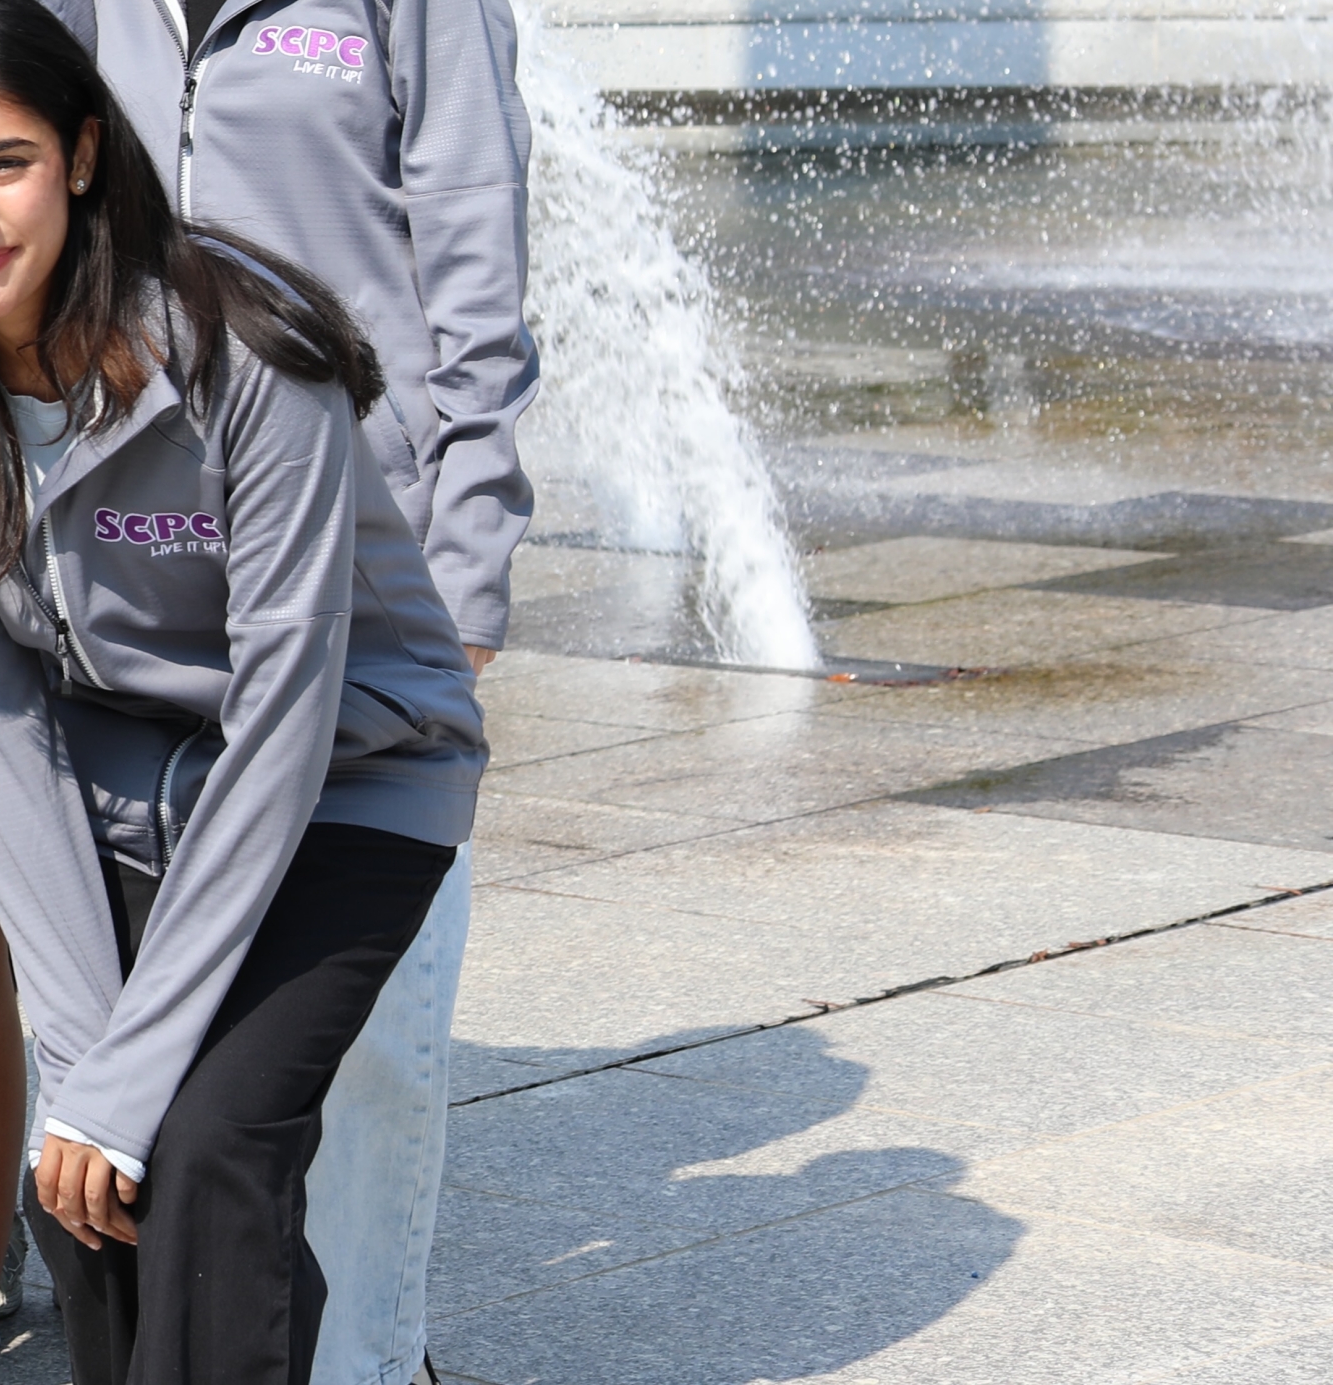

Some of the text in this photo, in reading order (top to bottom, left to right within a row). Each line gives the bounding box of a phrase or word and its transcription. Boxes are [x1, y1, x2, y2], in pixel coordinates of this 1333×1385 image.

[252, 26, 368, 67] SCPC
[293, 60, 363, 84] LIVE IT UP!
[95, 508, 224, 544] SCPC
[151, 541, 227, 557] LIVE IT UP!
